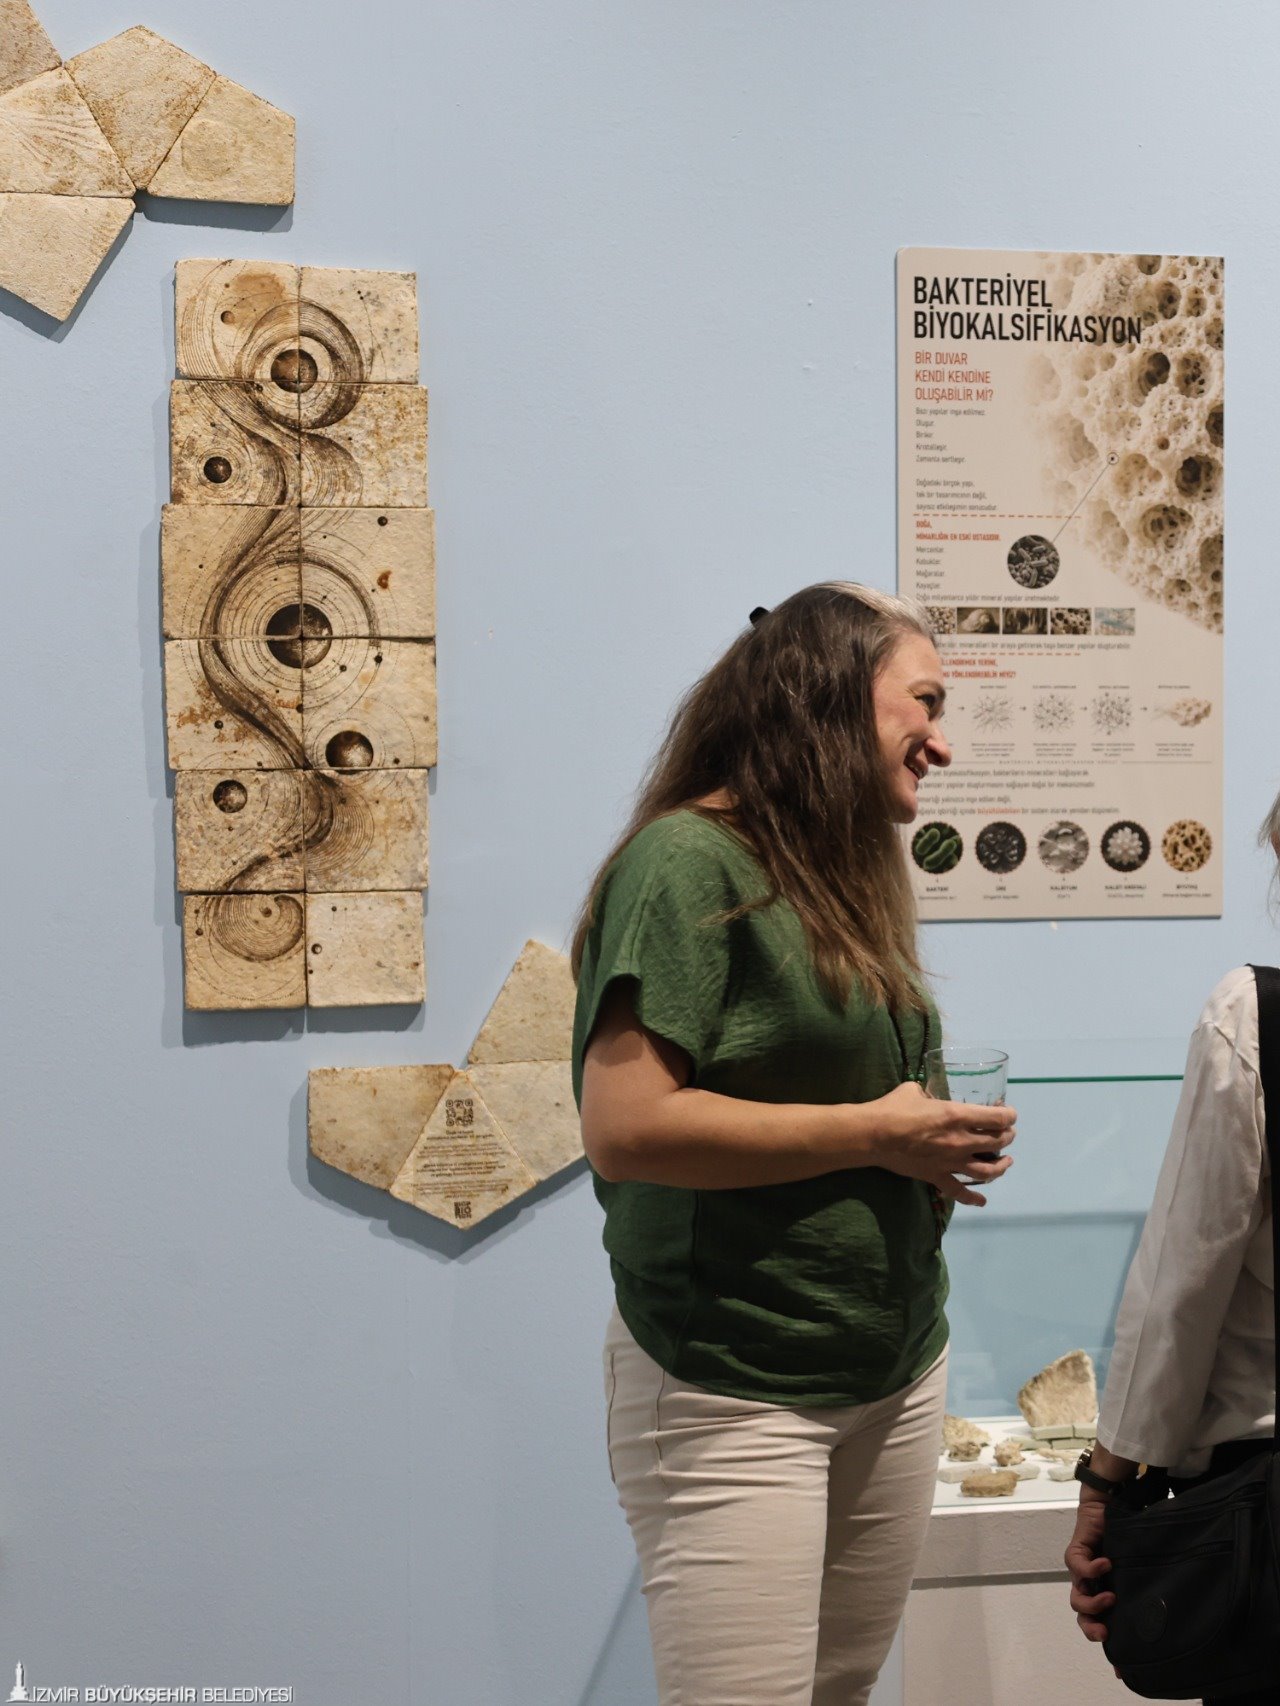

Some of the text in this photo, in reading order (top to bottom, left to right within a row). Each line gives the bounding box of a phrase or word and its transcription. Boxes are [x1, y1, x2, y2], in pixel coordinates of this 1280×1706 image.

[914, 273, 1053, 307] BAKTERİYEL
[914, 306, 1141, 344] BİYOKALSİFİKASYON
[915, 350, 968, 365] BİR DUVAR
[915, 367, 991, 384] KENDİ KENDİNE
[915, 386, 973, 404] OLUŞABİLİR
